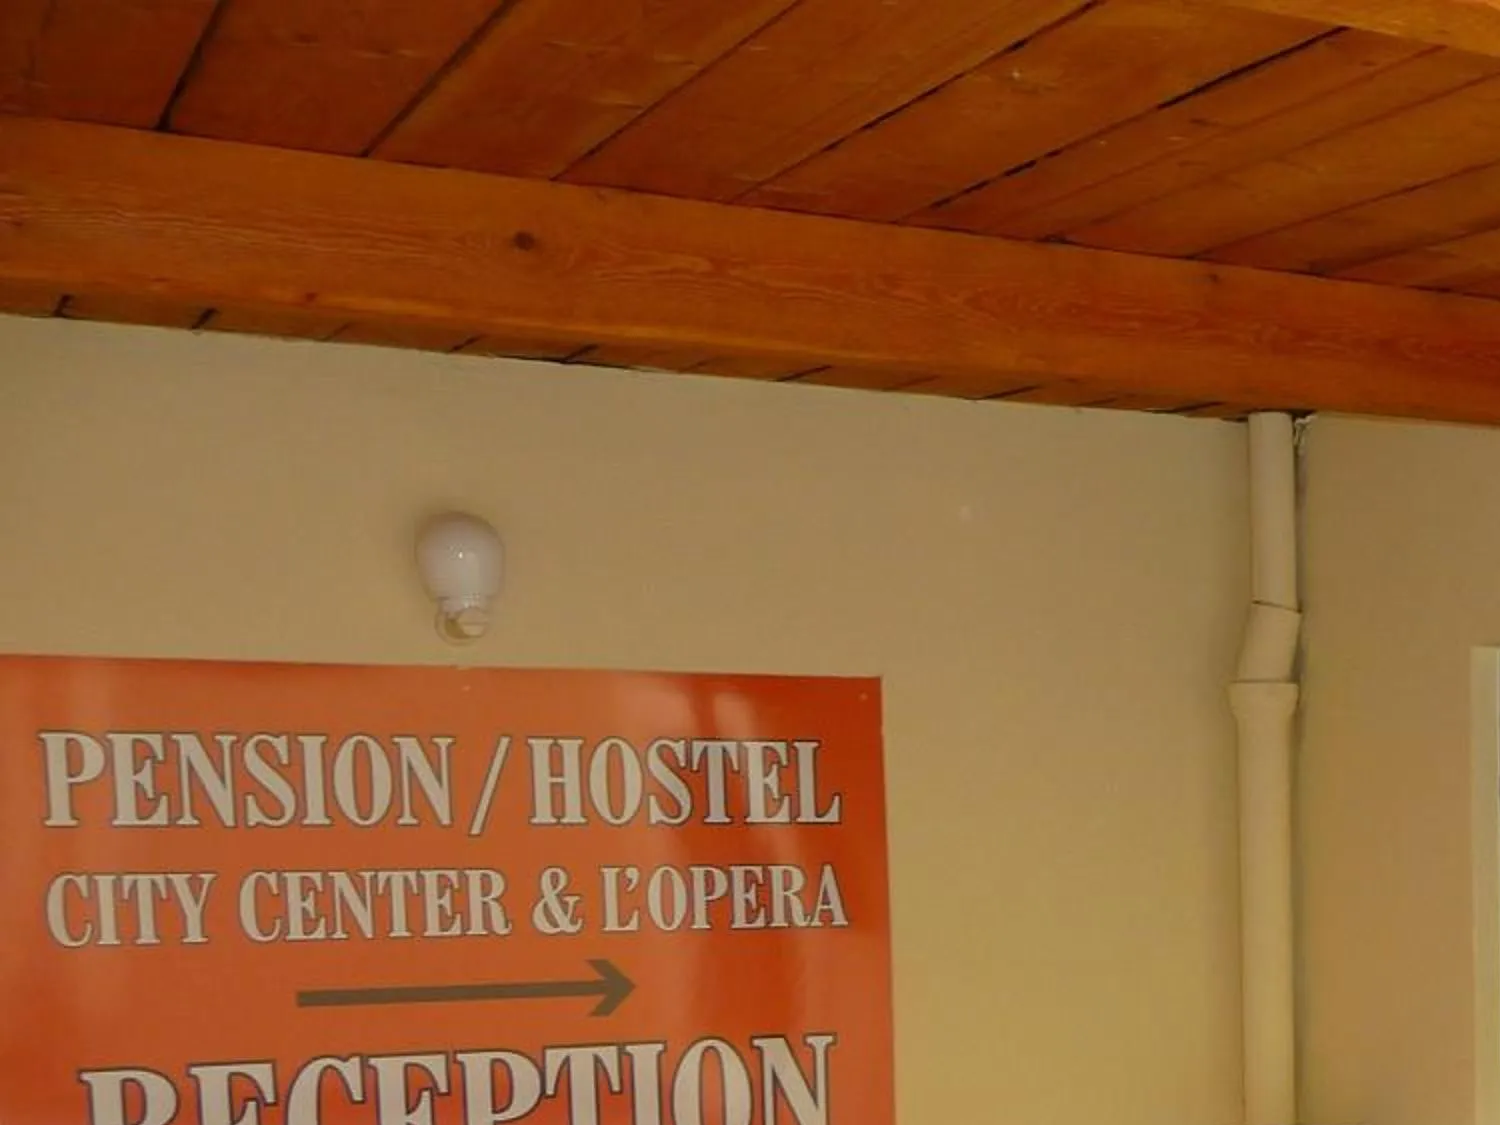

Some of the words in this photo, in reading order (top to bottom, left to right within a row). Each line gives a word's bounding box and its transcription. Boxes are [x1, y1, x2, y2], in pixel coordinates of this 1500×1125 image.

[38, 730, 456, 828] PENSION
[527, 736, 841, 825] HOSTEL
[45, 871, 217, 948] CITY
[238, 867, 512, 943] CENTER
[532, 866, 584, 935] &
